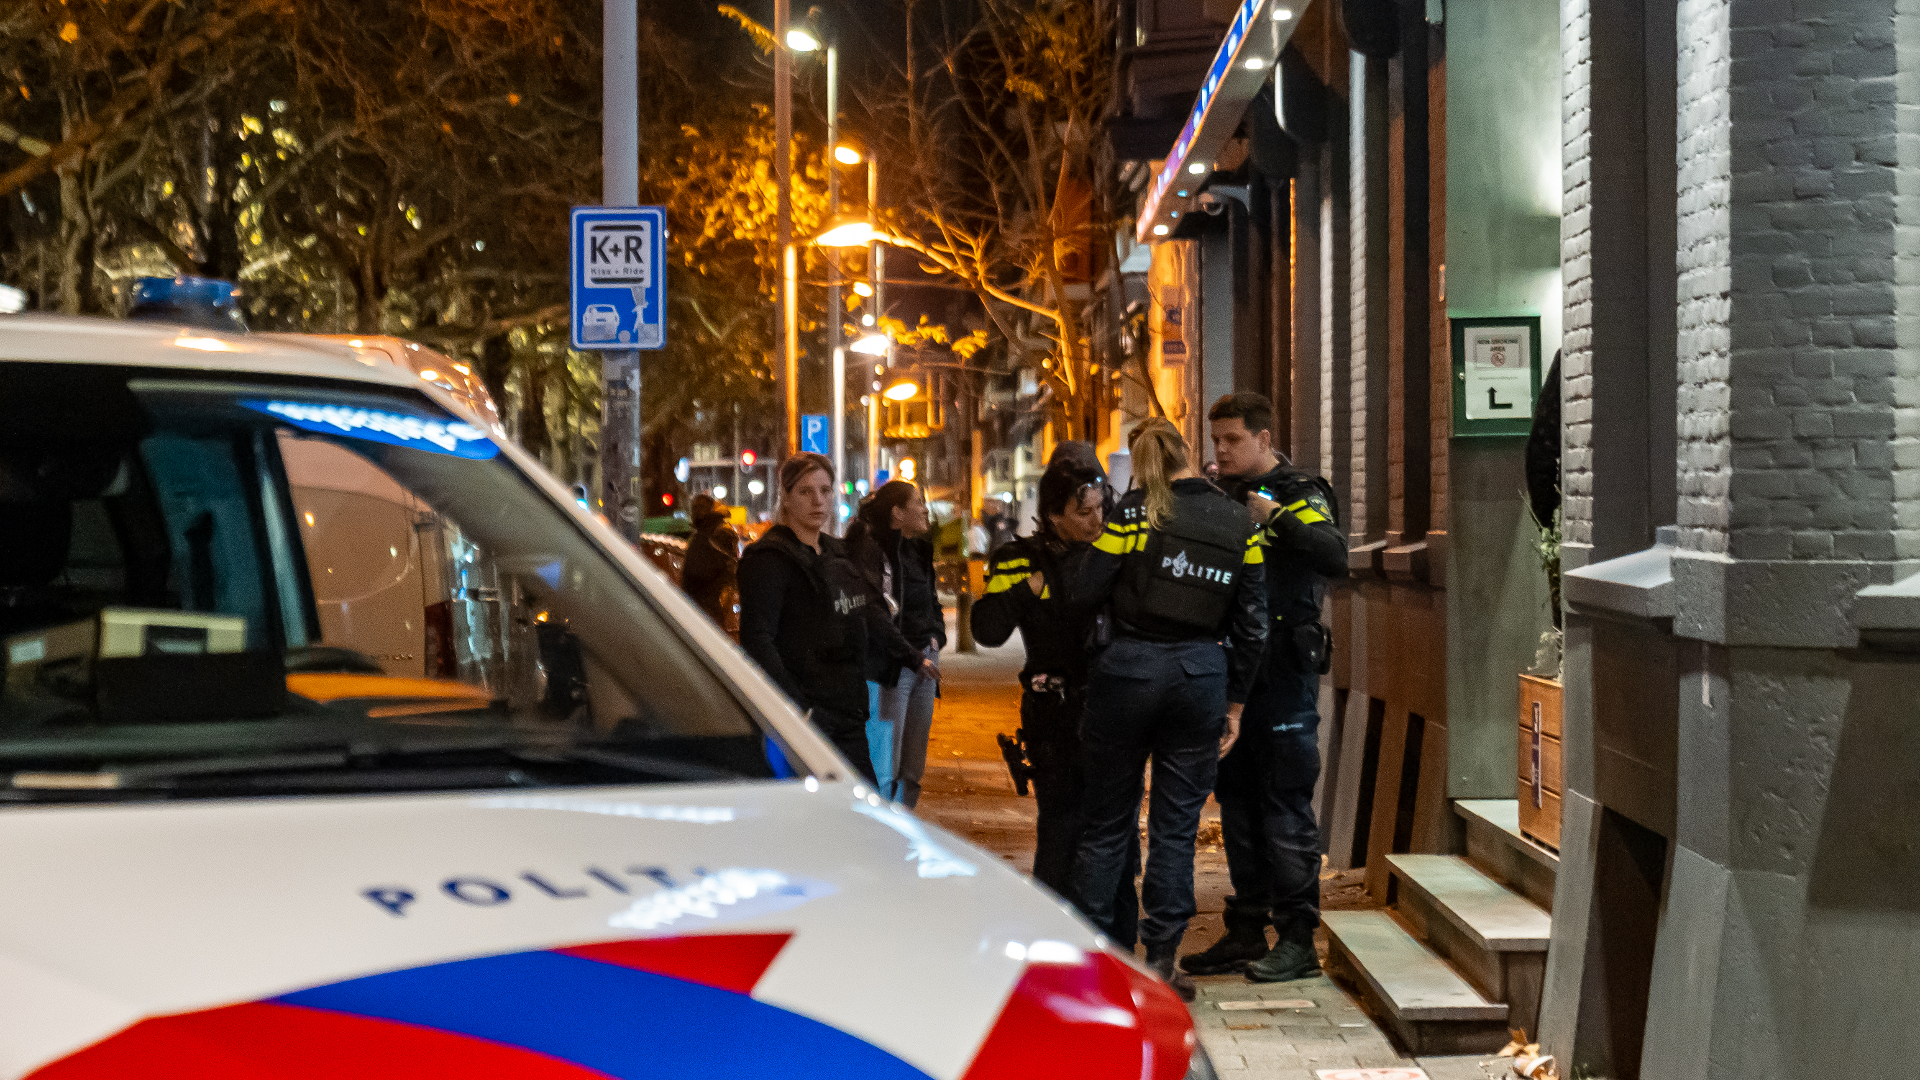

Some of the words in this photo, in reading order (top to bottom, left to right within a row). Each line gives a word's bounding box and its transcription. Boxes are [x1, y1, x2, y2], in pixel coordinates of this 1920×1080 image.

[590, 235, 644, 264] K+R
[622, 267, 644, 275] Ride
[1162, 551, 1232, 585] POLITIE
[360, 864, 806, 917] POLIT
